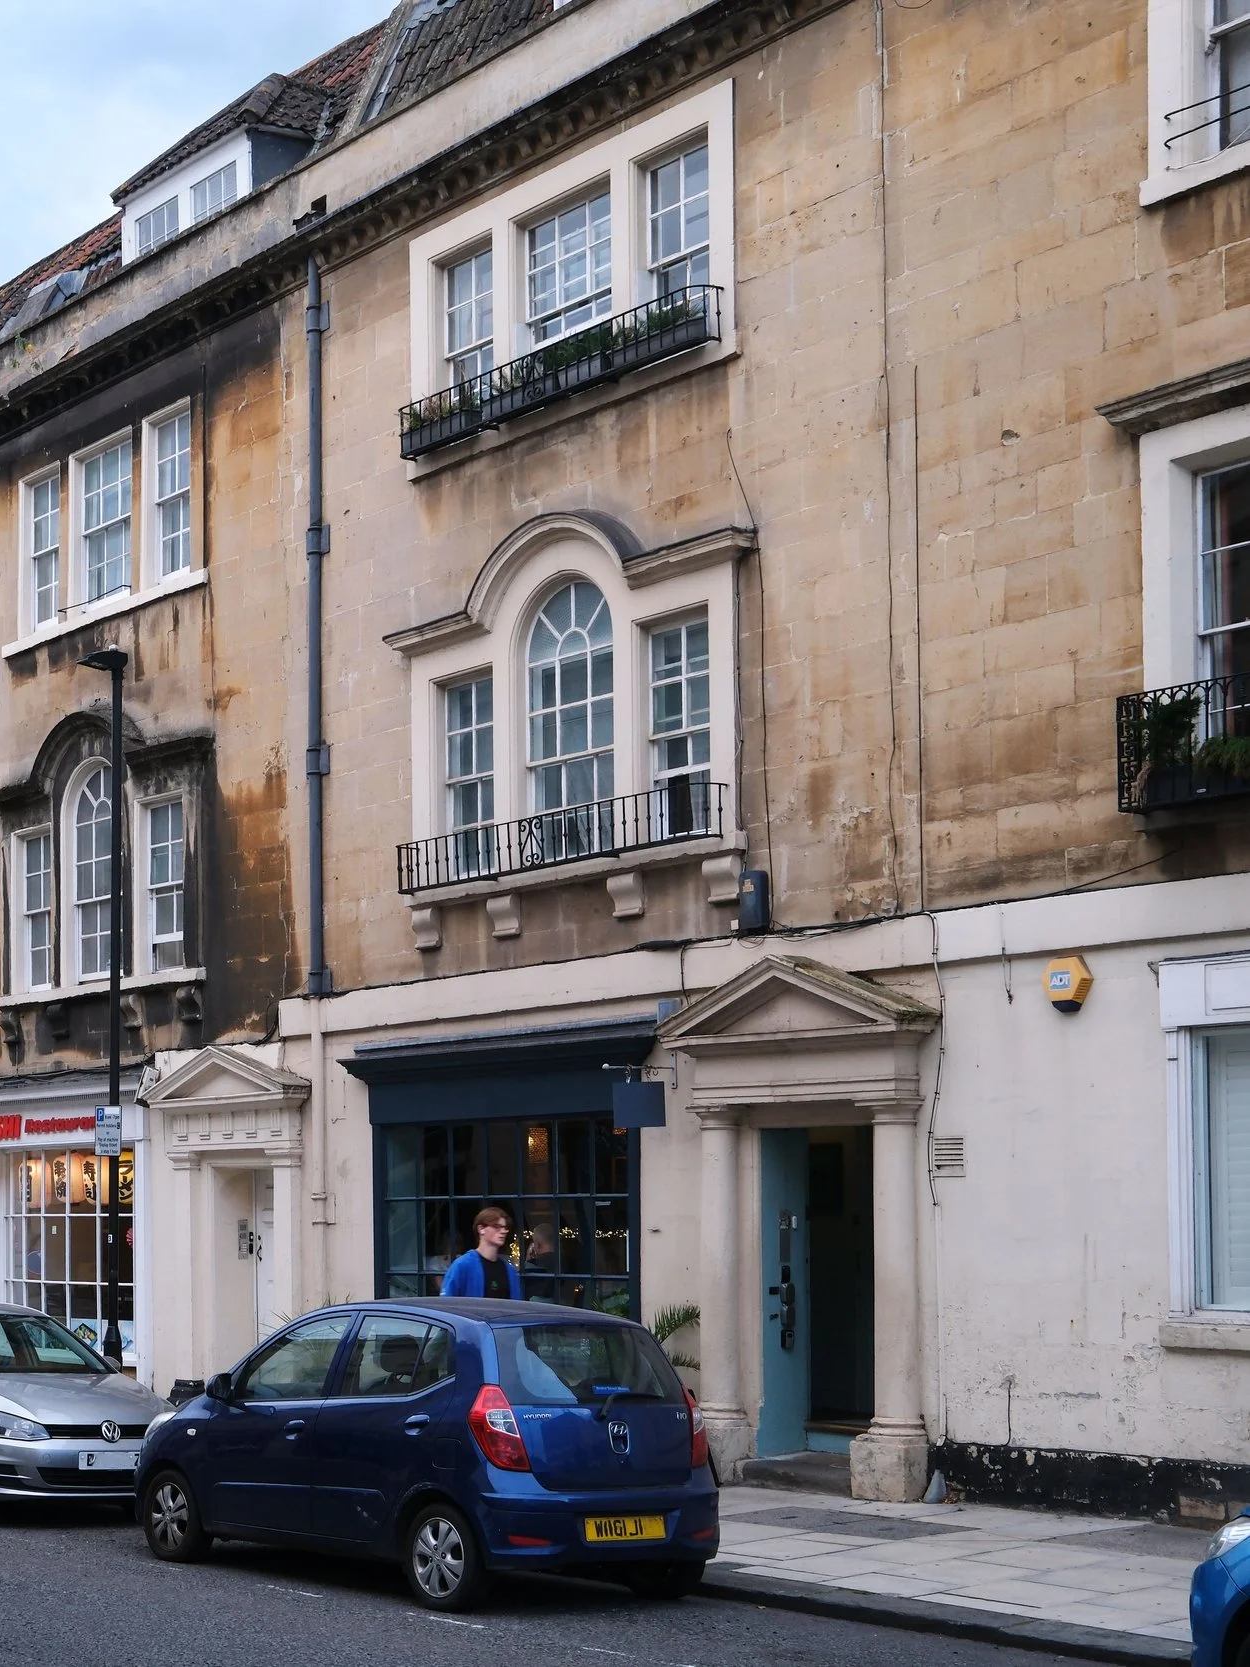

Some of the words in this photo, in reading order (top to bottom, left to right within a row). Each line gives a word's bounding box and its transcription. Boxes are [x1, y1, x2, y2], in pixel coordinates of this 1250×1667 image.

[1051, 974, 1070, 987] ADT
[98, 1109, 104, 1121] P
[25, 1117, 95, 1134] Restauran
[676, 1412, 687, 1421] i10
